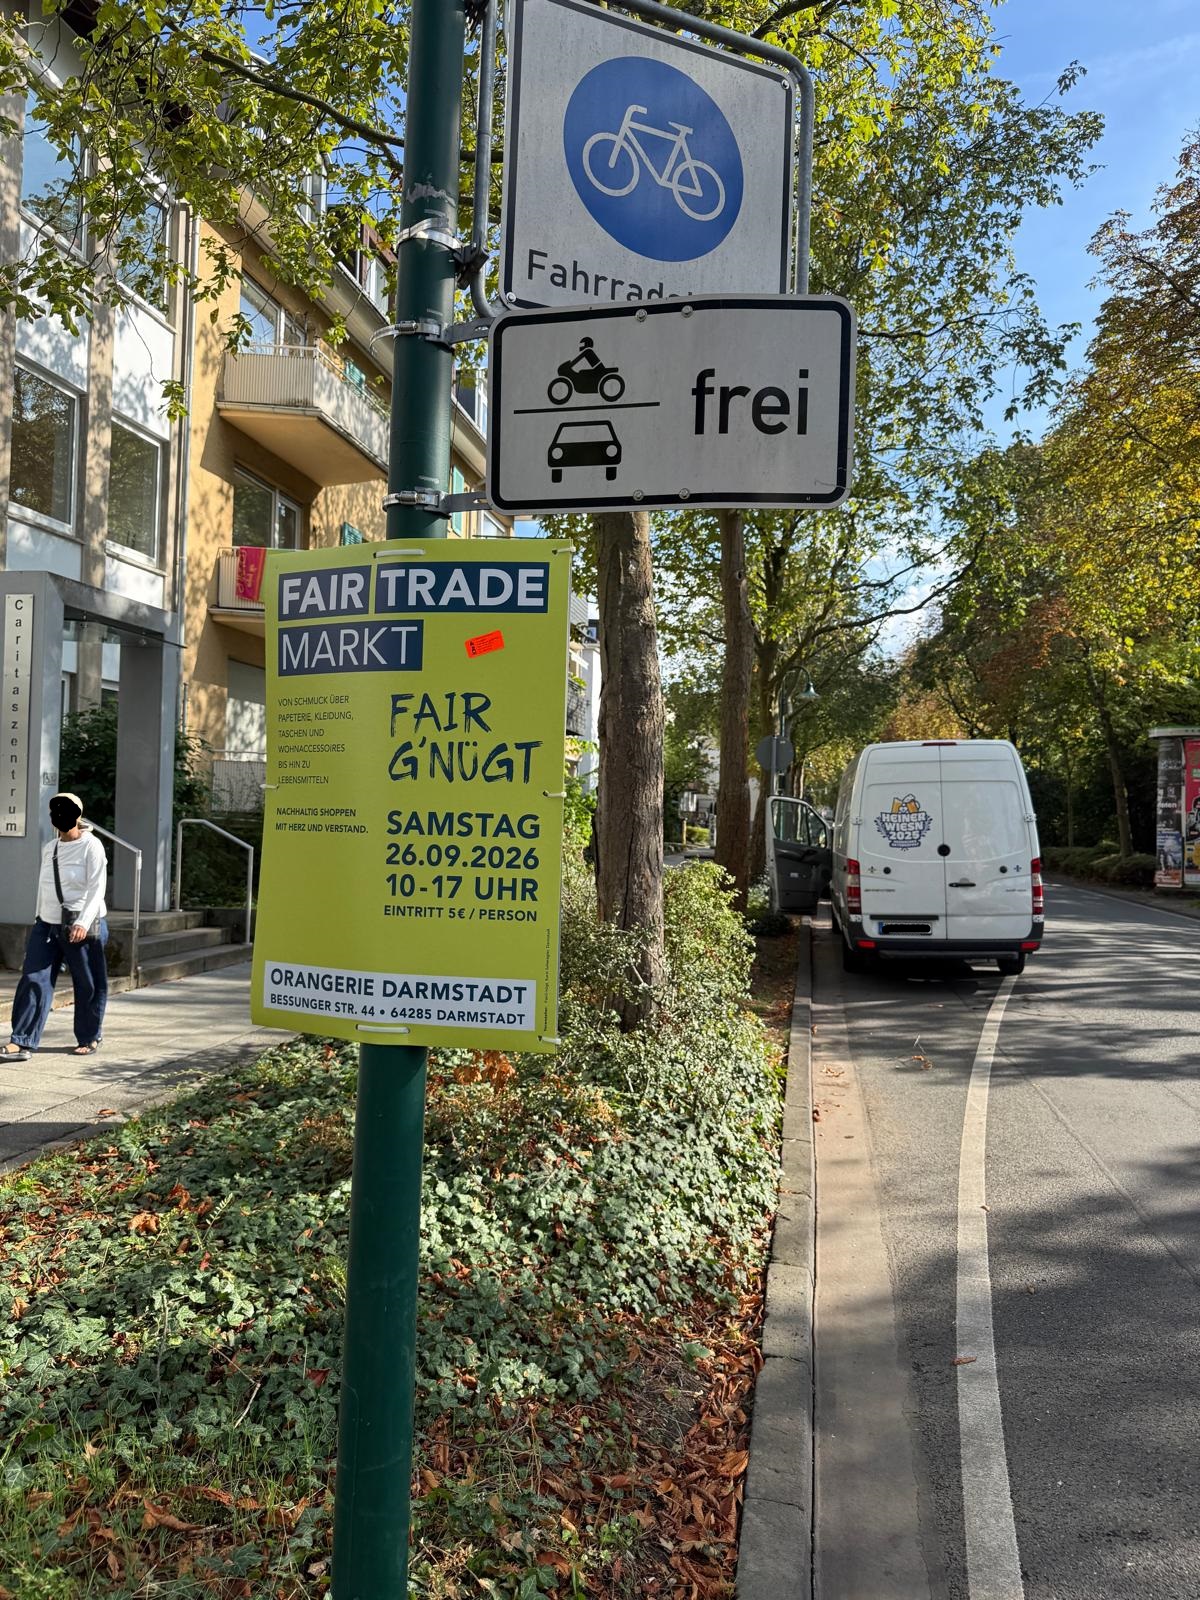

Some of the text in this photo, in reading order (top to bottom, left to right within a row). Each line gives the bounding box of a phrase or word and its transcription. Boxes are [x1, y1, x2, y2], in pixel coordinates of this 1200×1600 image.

[528, 249, 693, 301] Fahrrad
[691, 368, 809, 435] frei
[282, 572, 365, 614] FAIR
[380, 568, 545, 607] TRADE
[282, 626, 418, 670] MARKT
[278, 694, 350, 706] VON SCHMUCK ÜBER
[6, 600, 24, 832] Caritaszentrum
[278, 711, 354, 723] PAPETERIE, KLEIDUNG,
[390, 692, 492, 737] FAIR
[278, 728, 325, 738] TASCHEN UND
[278, 743, 346, 753] WOHNACCESSOIRES
[278, 760, 311, 769] BIS HIN ZU
[388, 736, 543, 784] G'NÜGT
[278, 775, 329, 784] LEBENSMITTELN
[276, 807, 357, 817] NACHHALTIG SHOPPEN
[881, 813, 926, 823] HEINER
[275, 822, 369, 834] MIT HERZ UND VERSTAND.
[386, 810, 540, 839] SAMSTAG
[884, 821, 924, 832] WIESN
[889, 830, 921, 840] 2025
[386, 843, 540, 870] 26.09.2026
[474, 876, 539, 901] UHR
[384, 904, 444, 918] EINTRITT
[448, 907, 466, 919] 5€
[479, 909, 537, 922] PERSON
[270, 967, 527, 1004] ORANGERIE DARMSTADT
[270, 993, 332, 1012] BESSUNGER
[334, 1002, 358, 1015] STR.
[361, 1006, 376, 1017] 44
[390, 1007, 432, 1020] 64285
[437, 1009, 526, 1025] DARMSTADT
